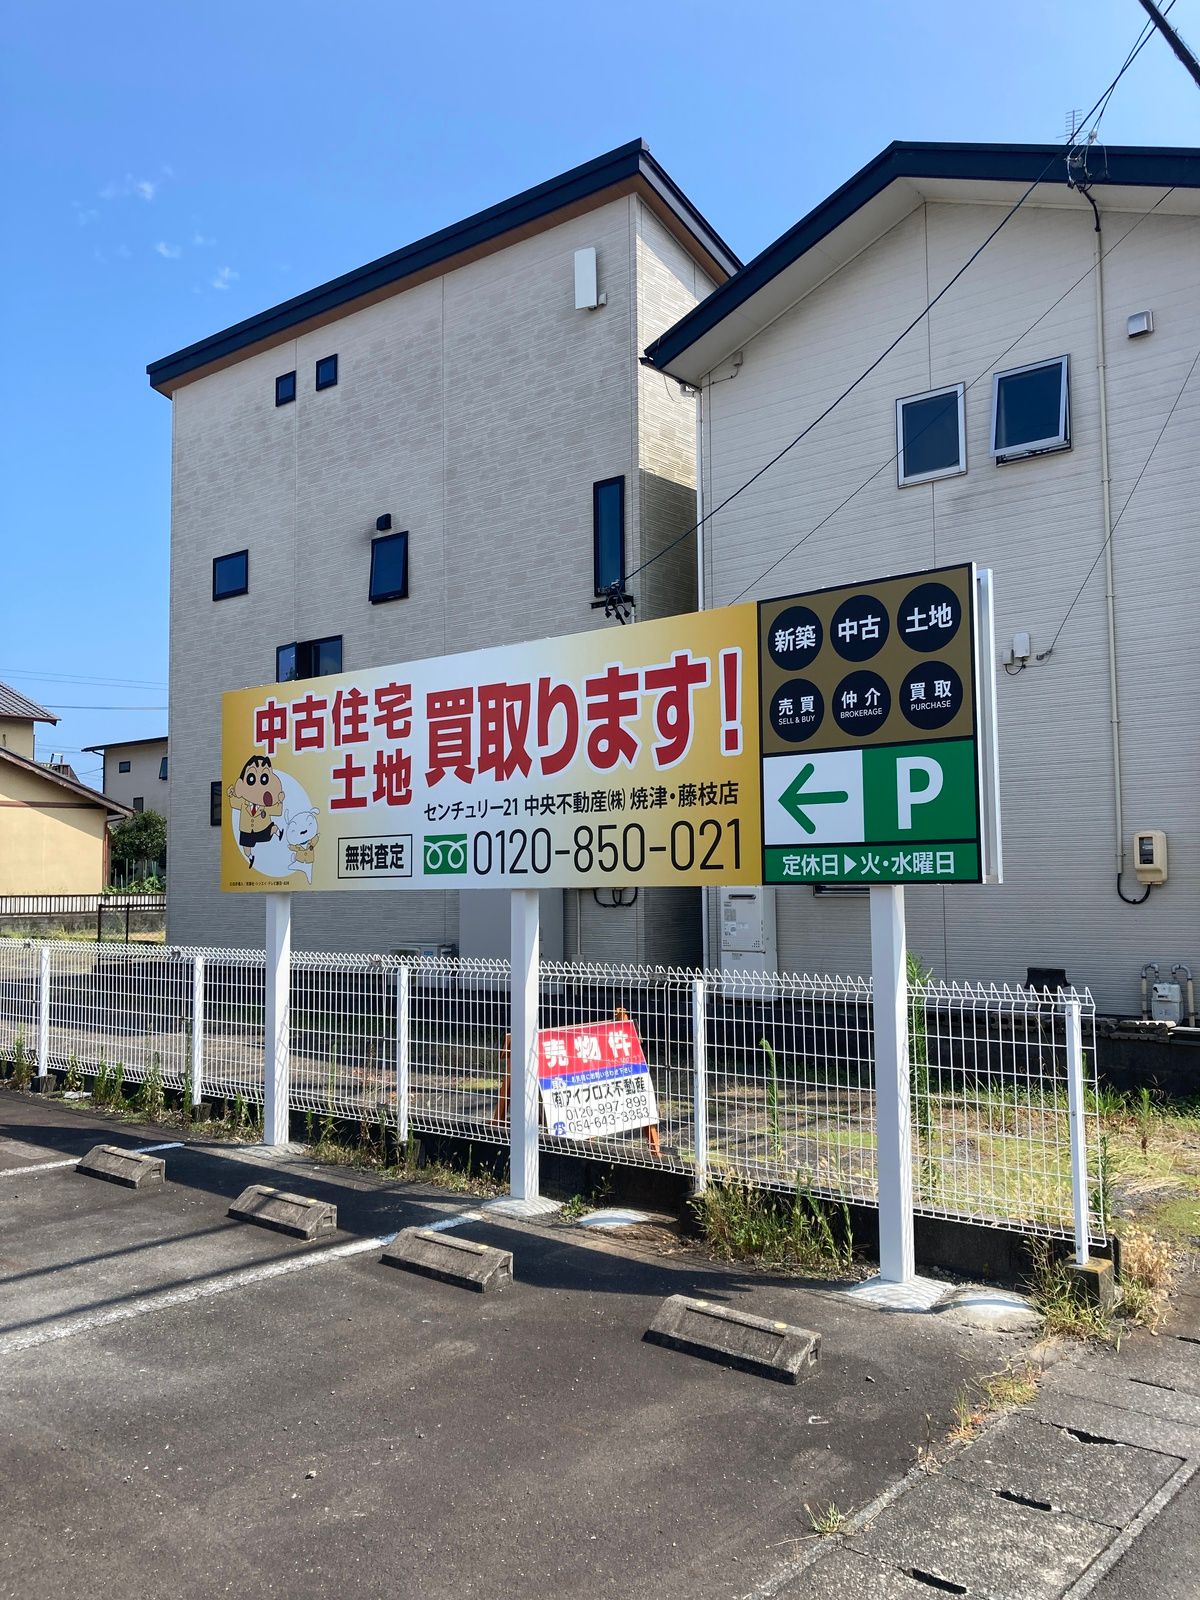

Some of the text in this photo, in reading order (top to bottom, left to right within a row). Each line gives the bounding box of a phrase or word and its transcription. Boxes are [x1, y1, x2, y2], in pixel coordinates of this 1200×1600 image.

[837, 614, 881, 643] 中古
[905, 602, 953, 633] 土地
[775, 624, 816, 653] 新築
[841, 687, 881, 710] 仲介
[910, 679, 952, 702] 買取
[255, 682, 413, 755] 中古住宅
[778, 695, 815, 716] 売買
[778, 717, 795, 726] SELL
[801, 714, 816, 724] BUY
[840, 707, 883, 719] BROKERAGE
[910, 700, 951, 711] PURCHASE
[330, 748, 413, 810] 土地
[896, 756, 944, 830] P
[423, 798, 519, 822] センチュリー21
[630, 781, 740, 811] 焼津・藤枝店
[345, 842, 405, 871] 無料査定
[473, 818, 742, 875] 0120-850-021
[782, 851, 955, 877] 定休日 火・水曜日
